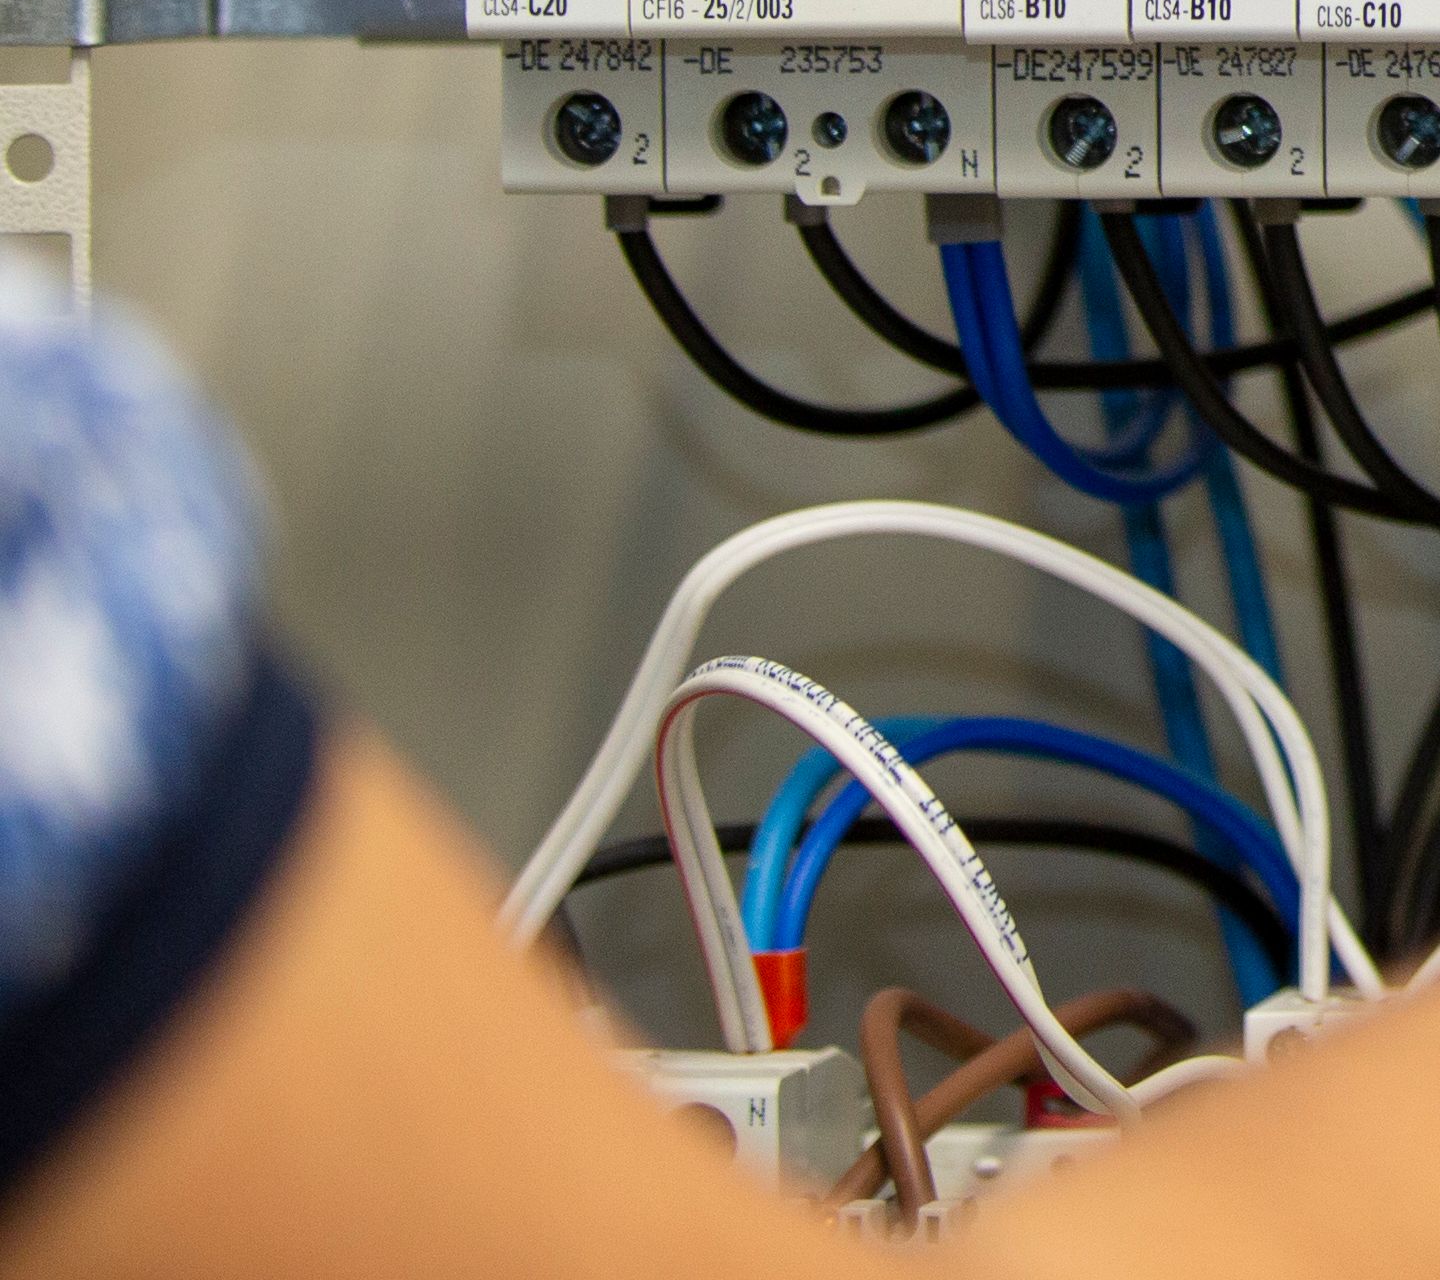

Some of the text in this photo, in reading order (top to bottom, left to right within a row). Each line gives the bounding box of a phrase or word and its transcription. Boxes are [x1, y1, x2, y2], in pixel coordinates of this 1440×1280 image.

[1318, 2, 1401, 28] CLS6-C10
[560, 41, 652, 71] 247842
[780, 45, 882, 73] 235753
[1217, 46, 1296, 77] 247827
[633, 132, 650, 165] 2
[794, 148, 811, 176] 2
[1125, 145, 1143, 178] 2
[1290, 147, 1304, 175] 2
[961, 149, 978, 177] N
[748, 1098, 767, 1127] N
